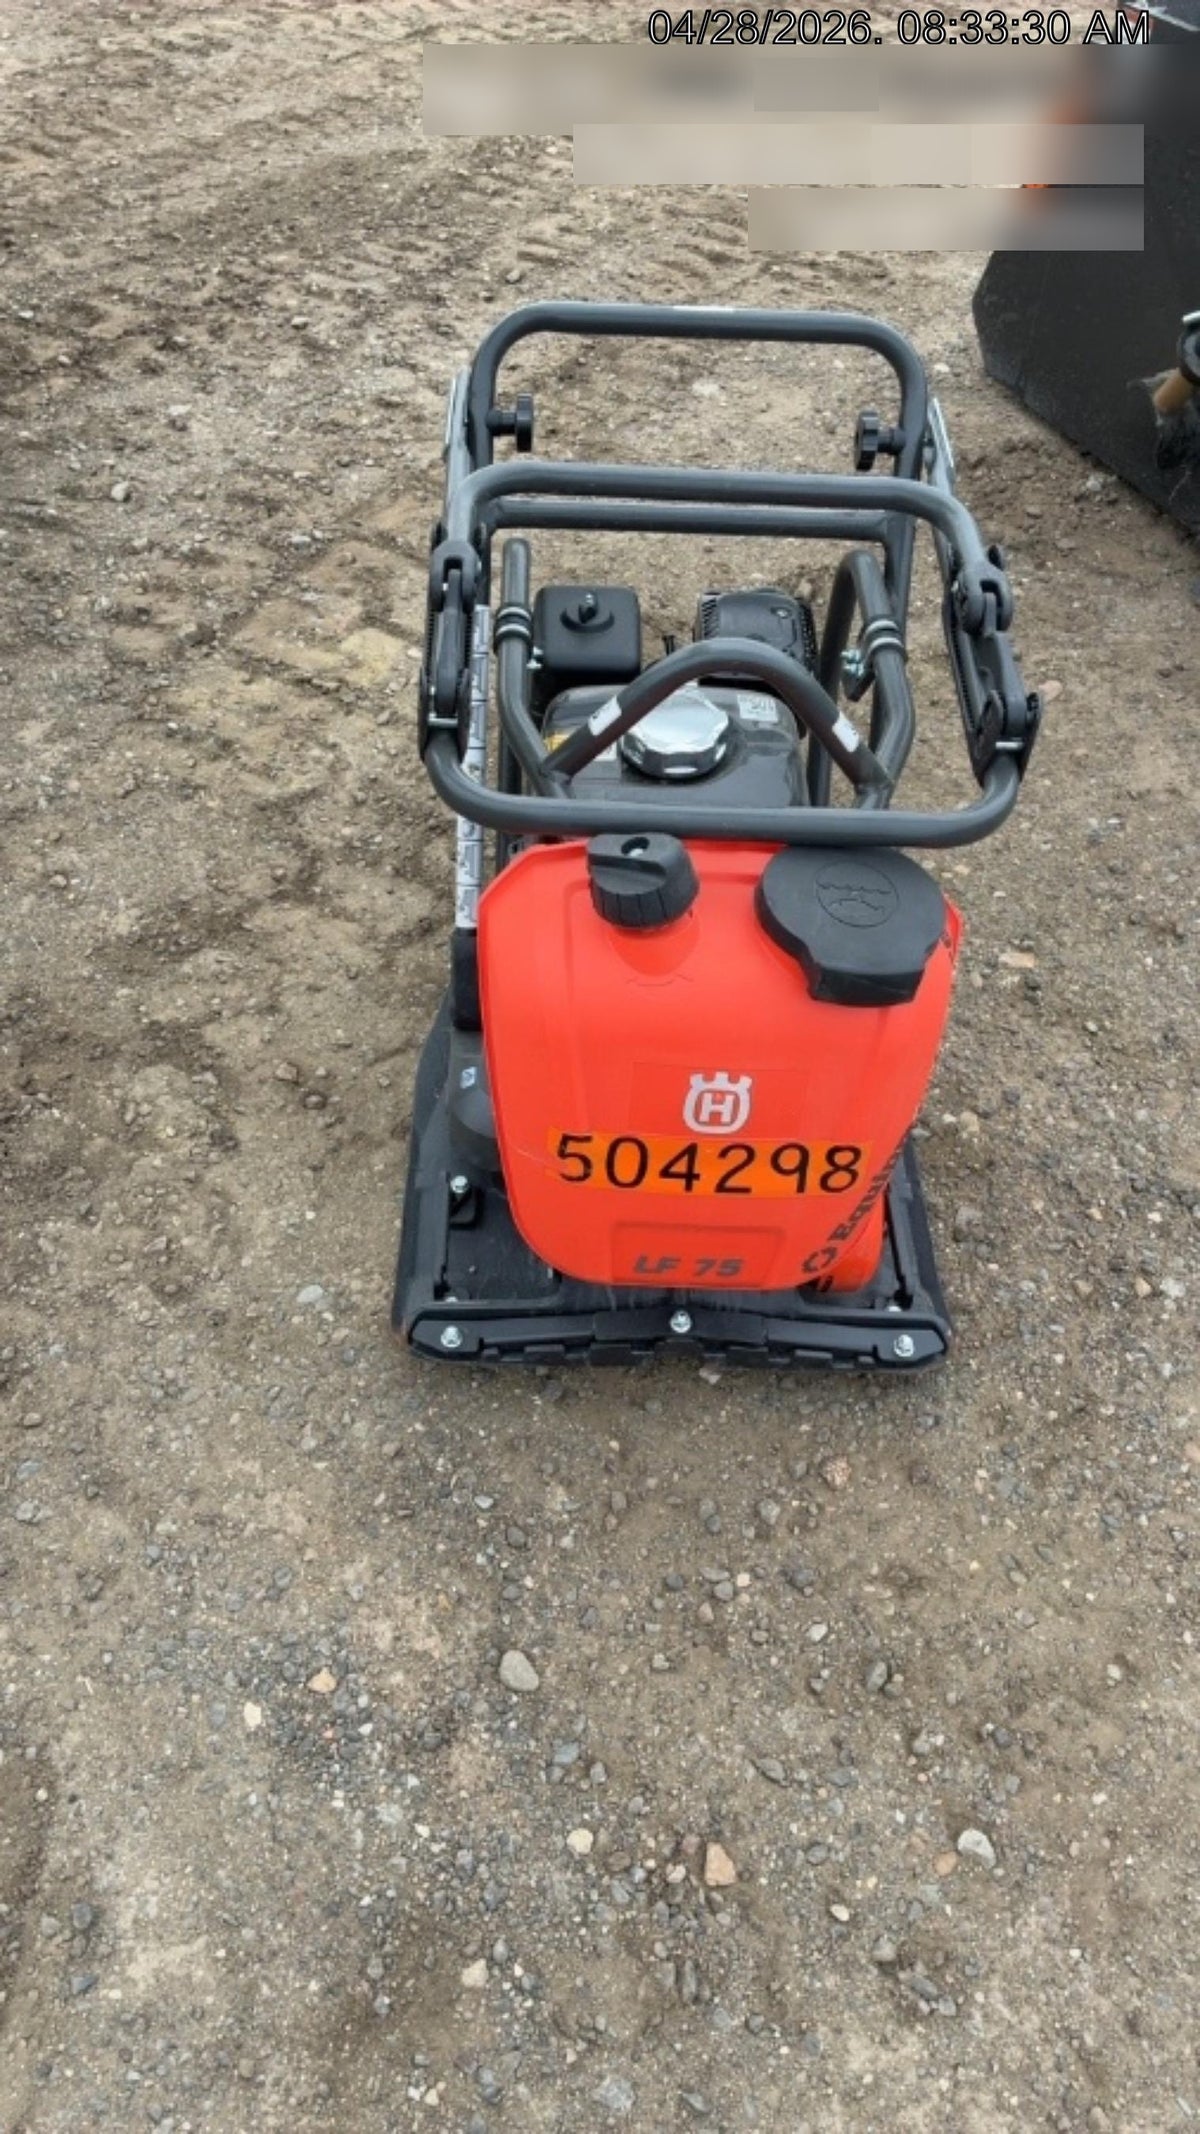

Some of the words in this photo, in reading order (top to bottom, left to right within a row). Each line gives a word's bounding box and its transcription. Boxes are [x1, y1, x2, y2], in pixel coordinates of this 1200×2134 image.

[557, 1134, 862, 1194] 504298
[633, 1255, 682, 1274] LF
[693, 1257, 744, 1277] 75
